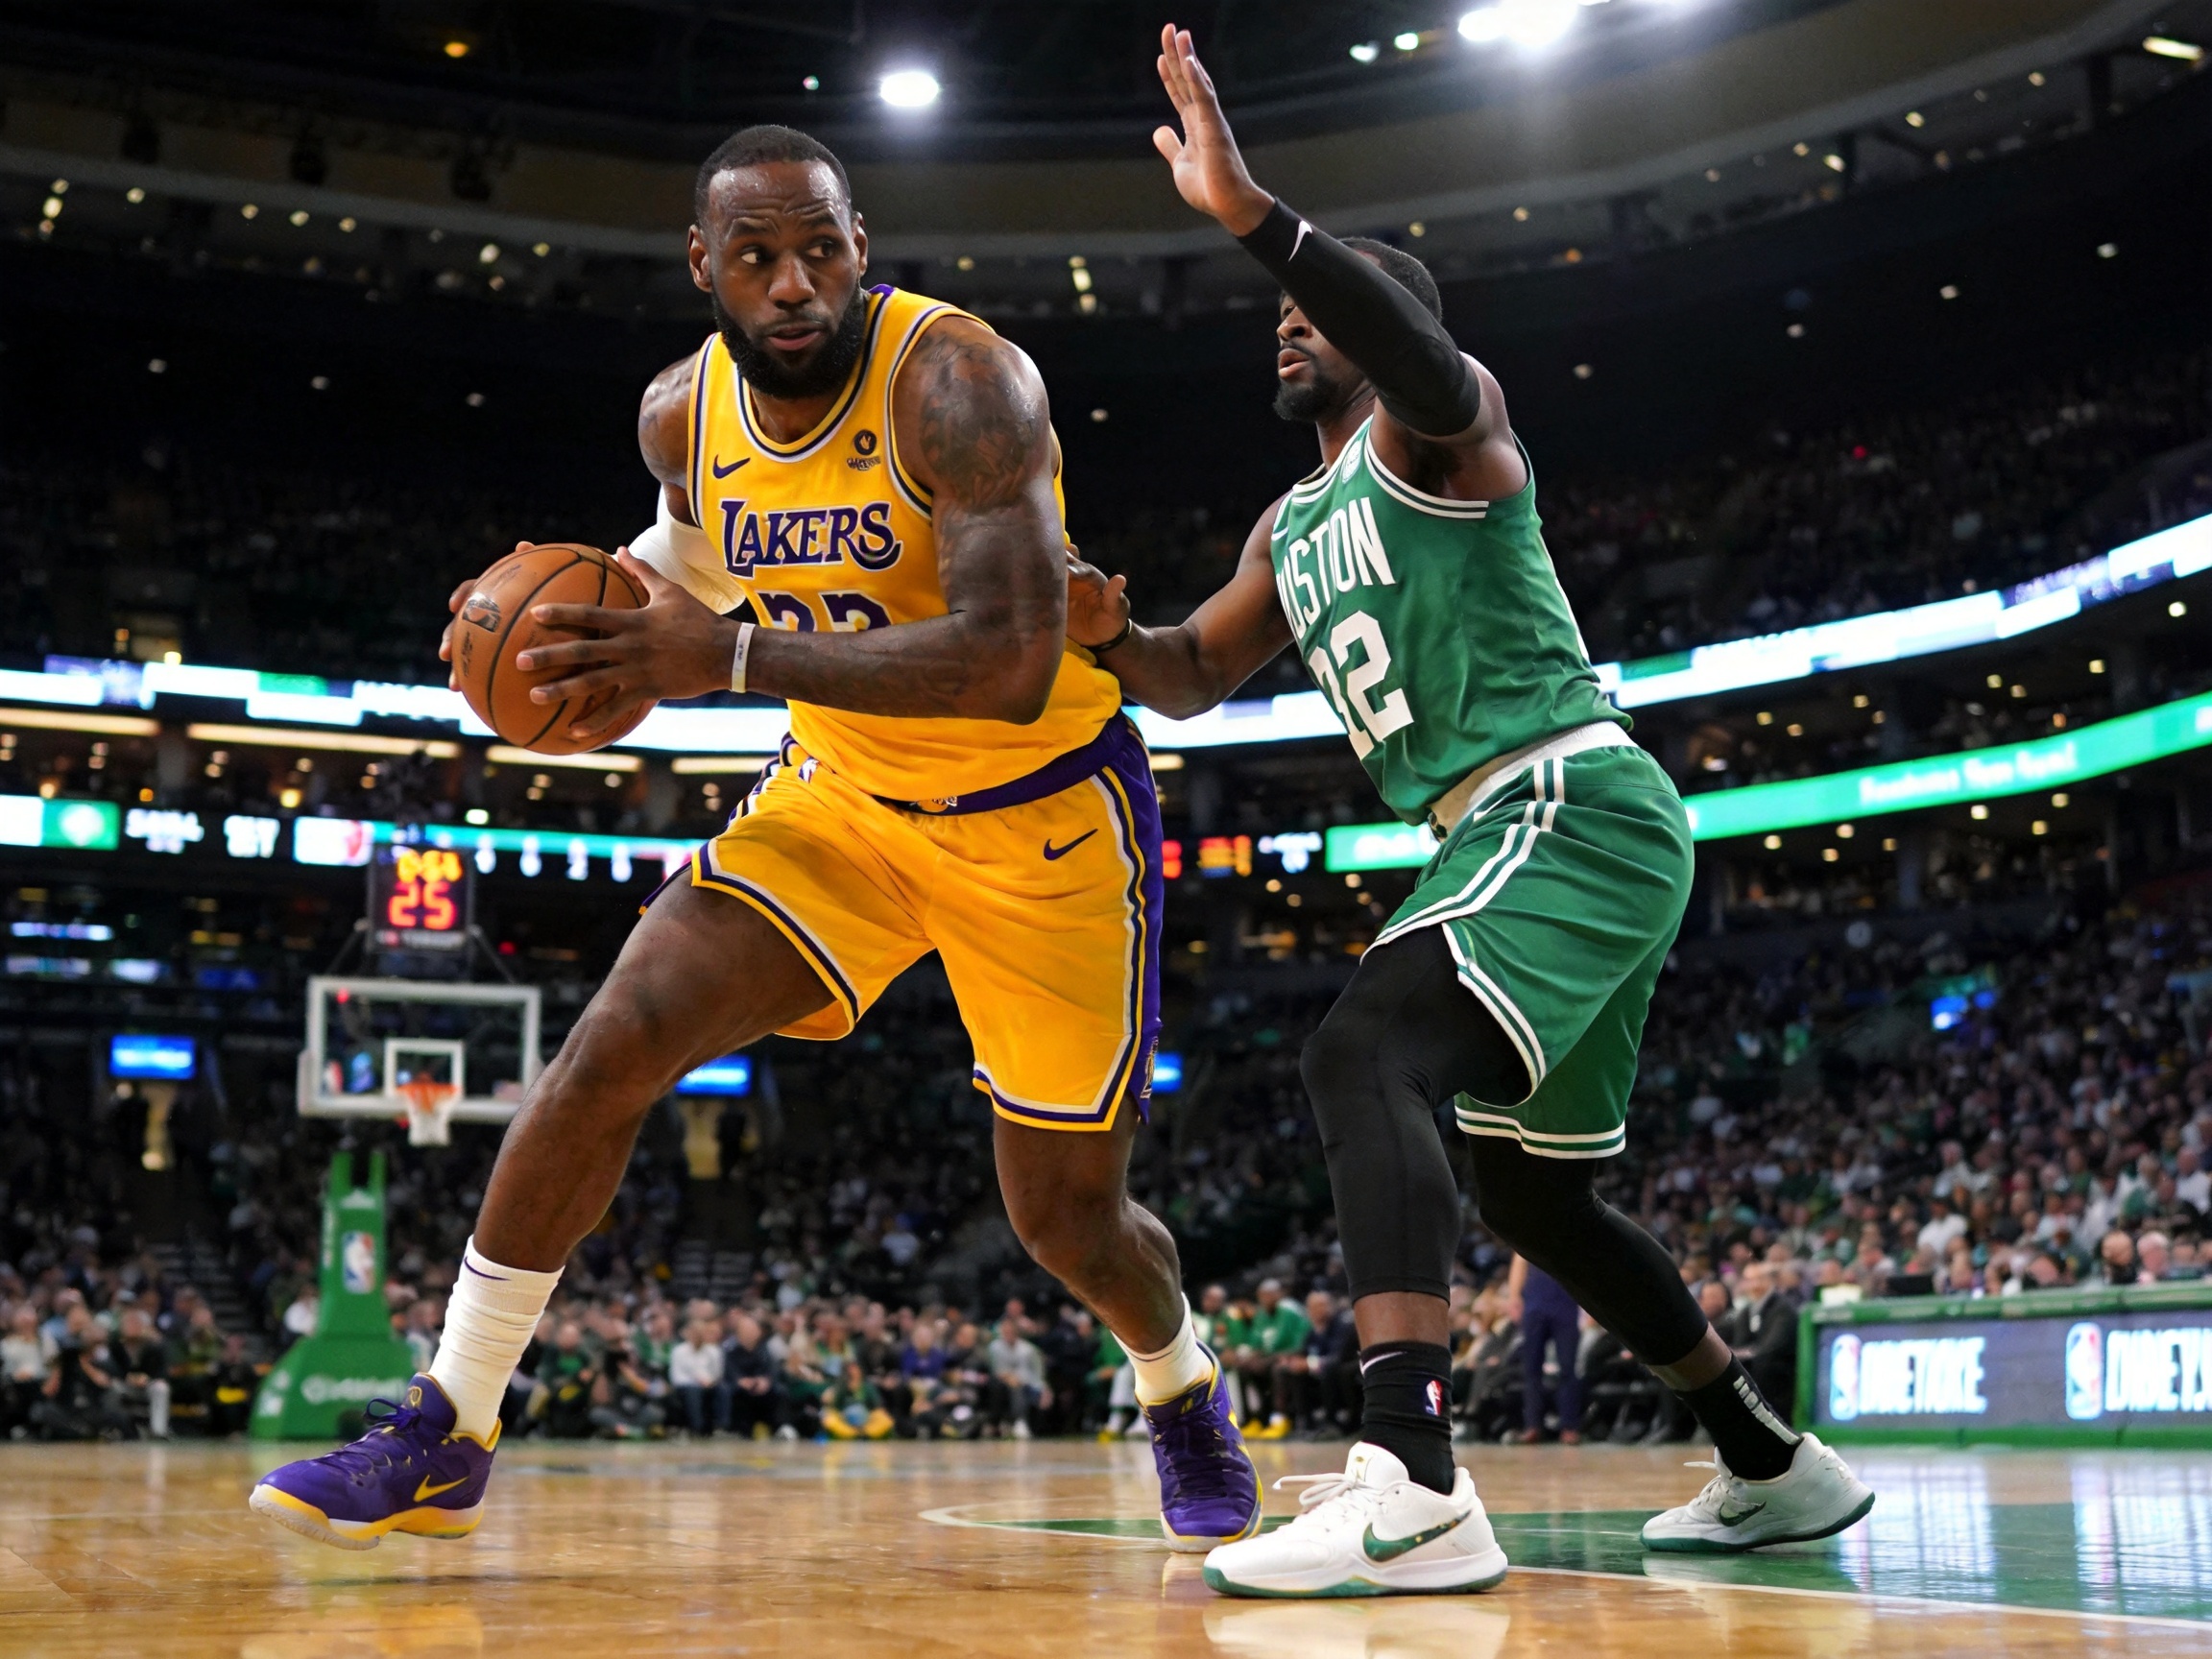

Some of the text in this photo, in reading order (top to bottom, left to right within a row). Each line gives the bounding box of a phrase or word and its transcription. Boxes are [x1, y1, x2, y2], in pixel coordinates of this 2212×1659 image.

[719, 498, 903, 579] LAKERS
[1276, 496, 1397, 639] OSTON
[389, 880, 456, 930] 25
